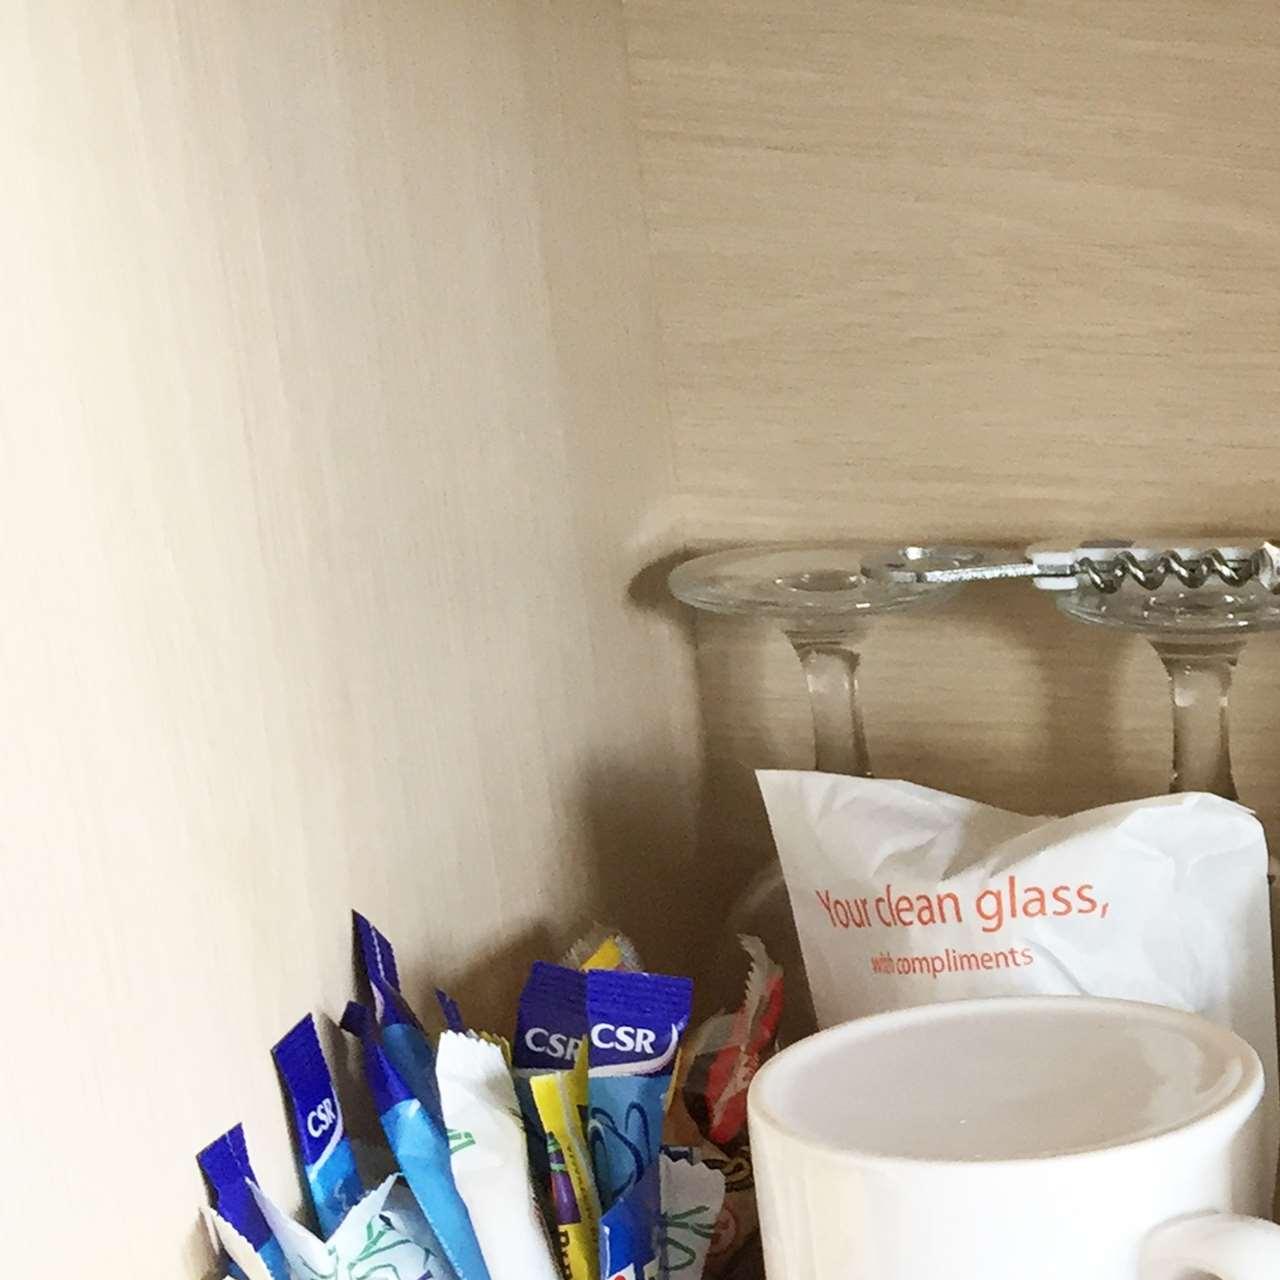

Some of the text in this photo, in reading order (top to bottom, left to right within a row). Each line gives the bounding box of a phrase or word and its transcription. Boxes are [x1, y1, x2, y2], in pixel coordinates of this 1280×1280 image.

[815, 875, 1111, 934] Your clean glass,
[870, 945, 1034, 979] with compliments
[525, 1027, 582, 1062] CSR
[590, 1022, 656, 1055] CSR
[306, 1098, 337, 1138] CSR
